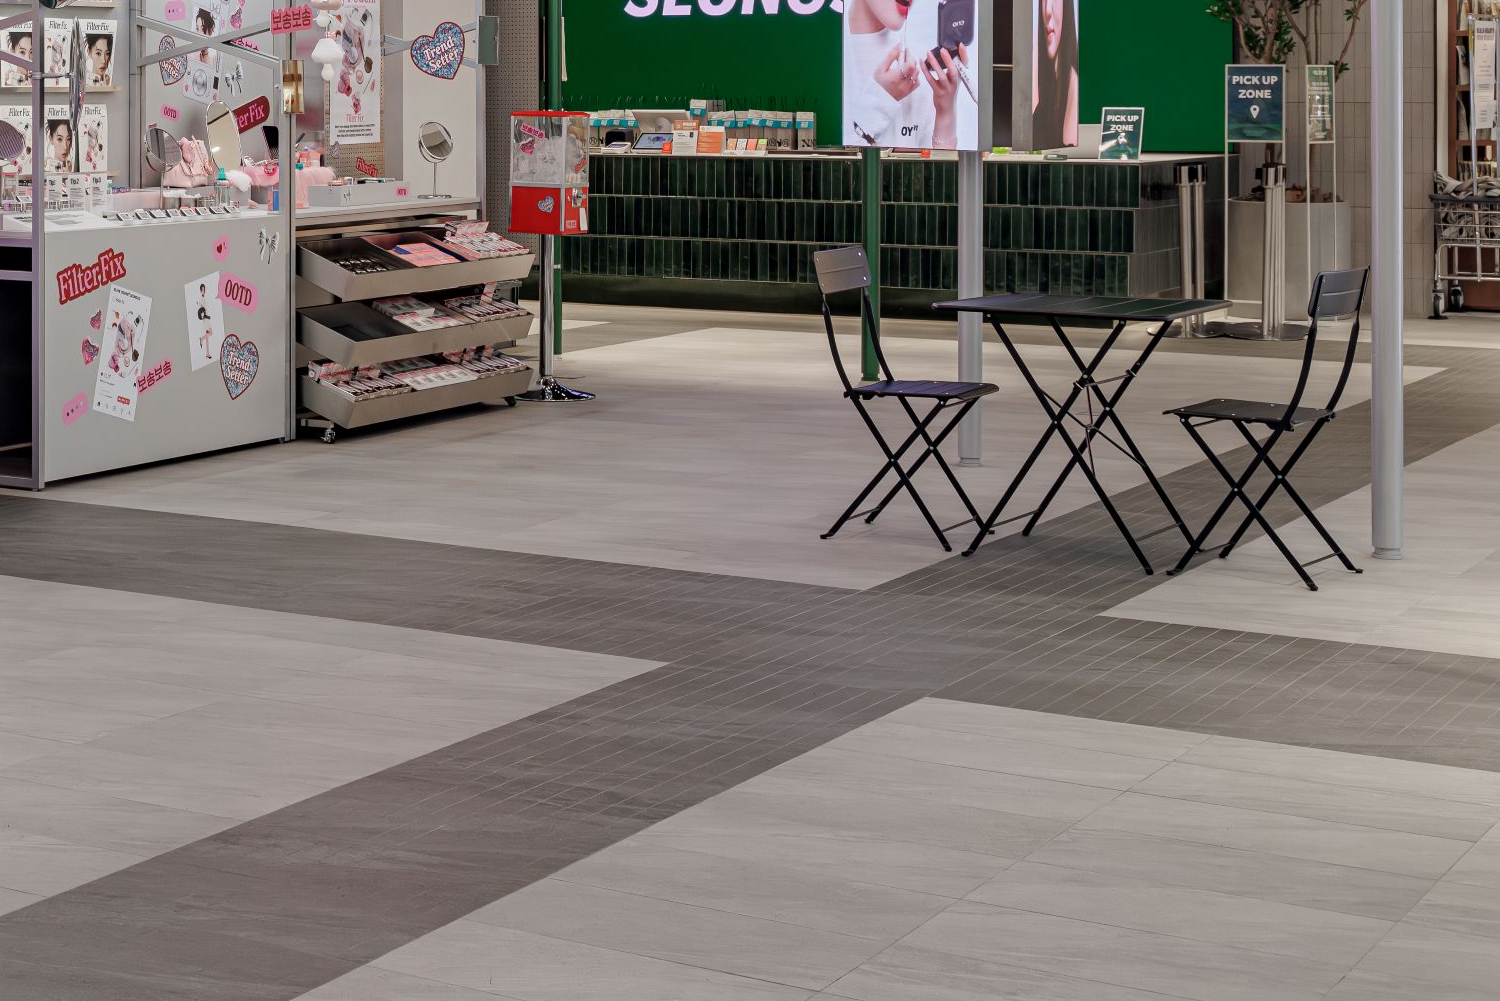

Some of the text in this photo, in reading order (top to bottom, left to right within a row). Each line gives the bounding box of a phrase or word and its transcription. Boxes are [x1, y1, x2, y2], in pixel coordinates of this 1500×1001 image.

[86, 21, 100, 31] Filter
[272, 8, 311, 31] 보송보송
[423, 36, 455, 61] Trend
[429, 49, 459, 72] Setter
[1232, 75, 1278, 85] PICK UP
[1238, 89, 1272, 99] ZONE
[163, 106, 177, 119] OOTD
[248, 103, 265, 123] Fix
[58, 251, 125, 303] Filter Fix
[224, 279, 252, 307] OOTD
[227, 350, 251, 373] Trend
[137, 360, 172, 393] 보송보송
[225, 365, 249, 385] Setter
